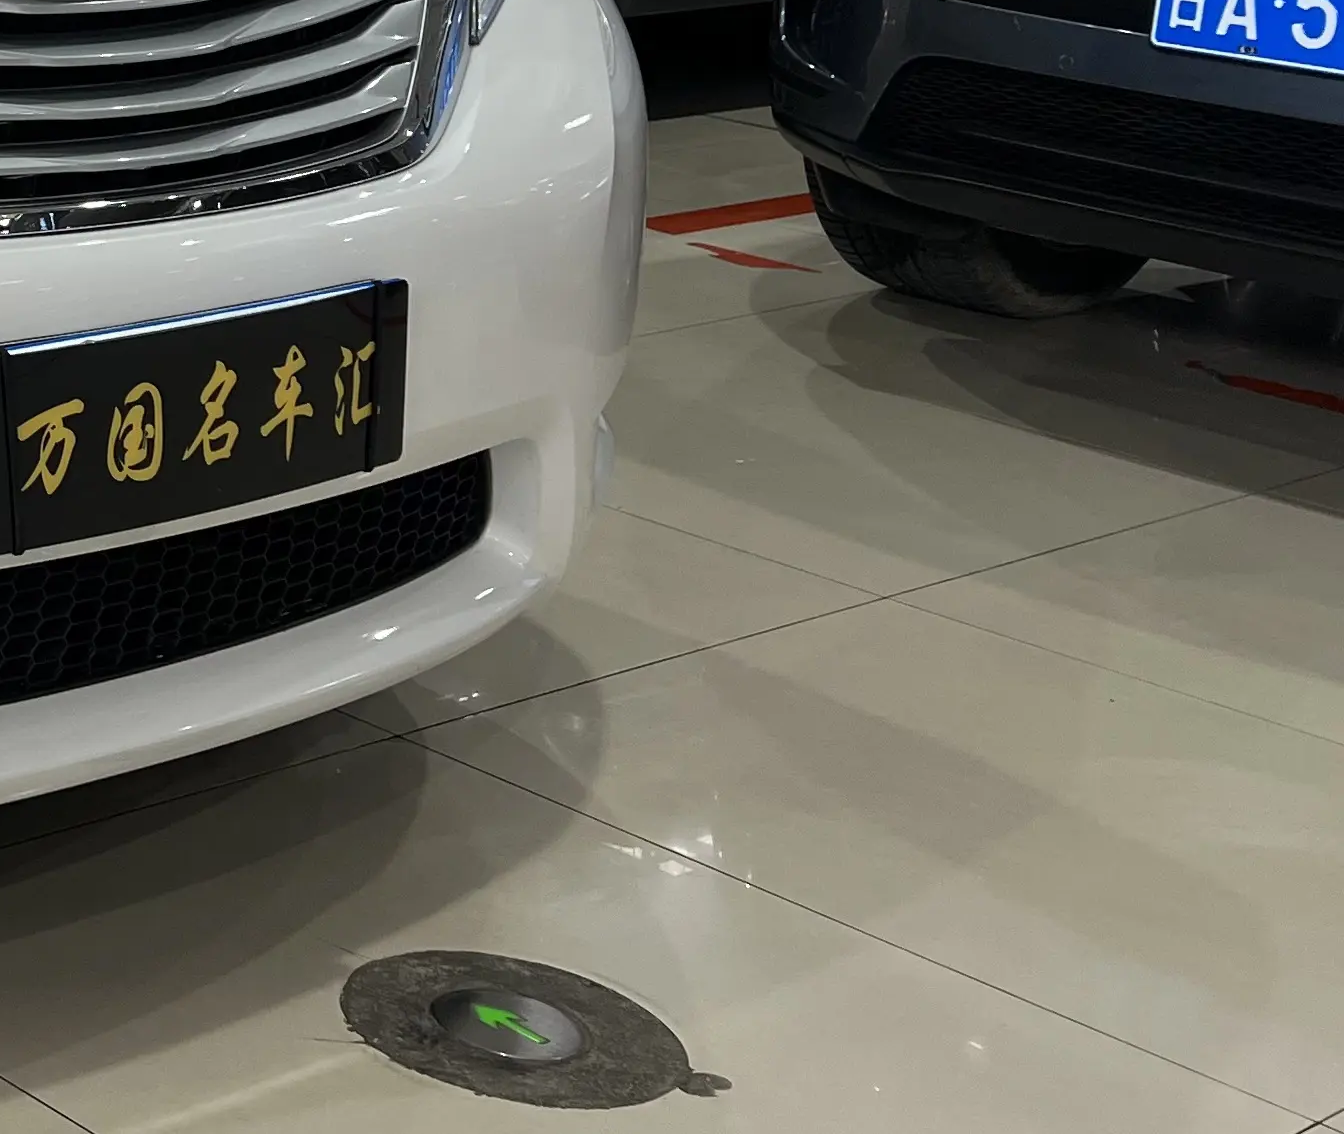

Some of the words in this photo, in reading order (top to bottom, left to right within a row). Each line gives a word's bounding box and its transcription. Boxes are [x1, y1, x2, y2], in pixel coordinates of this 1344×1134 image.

[16, 340, 377, 496] 万国名车汇
